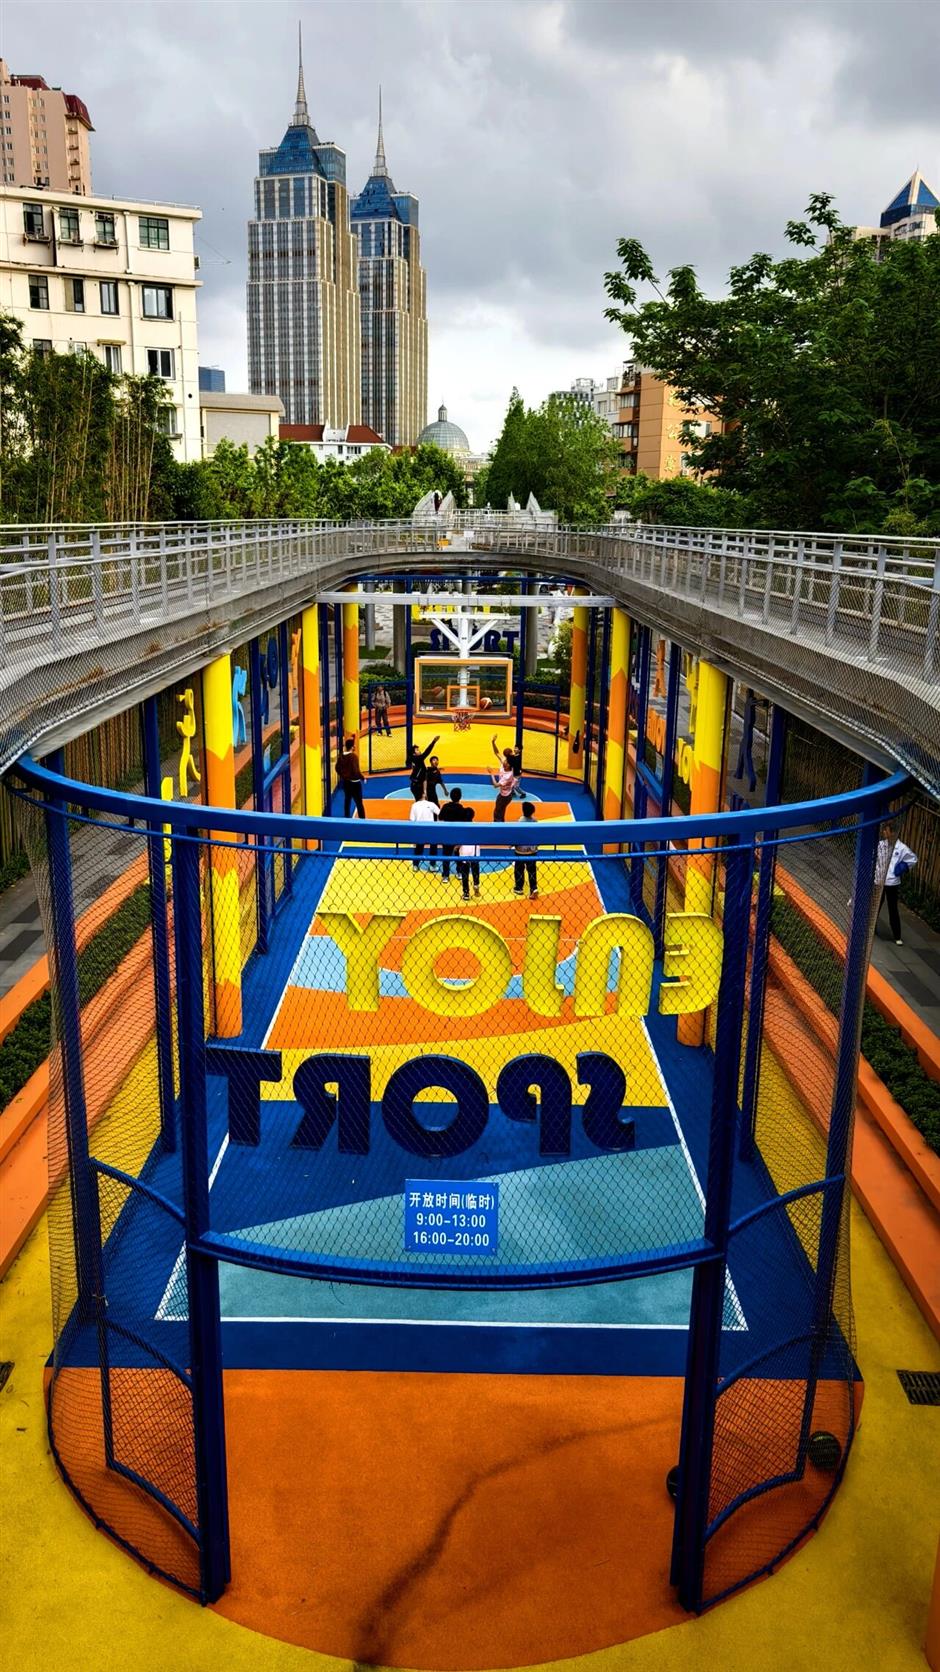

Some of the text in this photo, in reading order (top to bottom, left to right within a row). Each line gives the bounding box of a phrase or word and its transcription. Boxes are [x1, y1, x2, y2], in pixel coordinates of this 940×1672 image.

[409, 1192, 495, 1210] 开放时间(临时)
[416, 1213, 486, 1228] 9:00-13:00
[413, 1231, 490, 1247] 16:00-20:00
